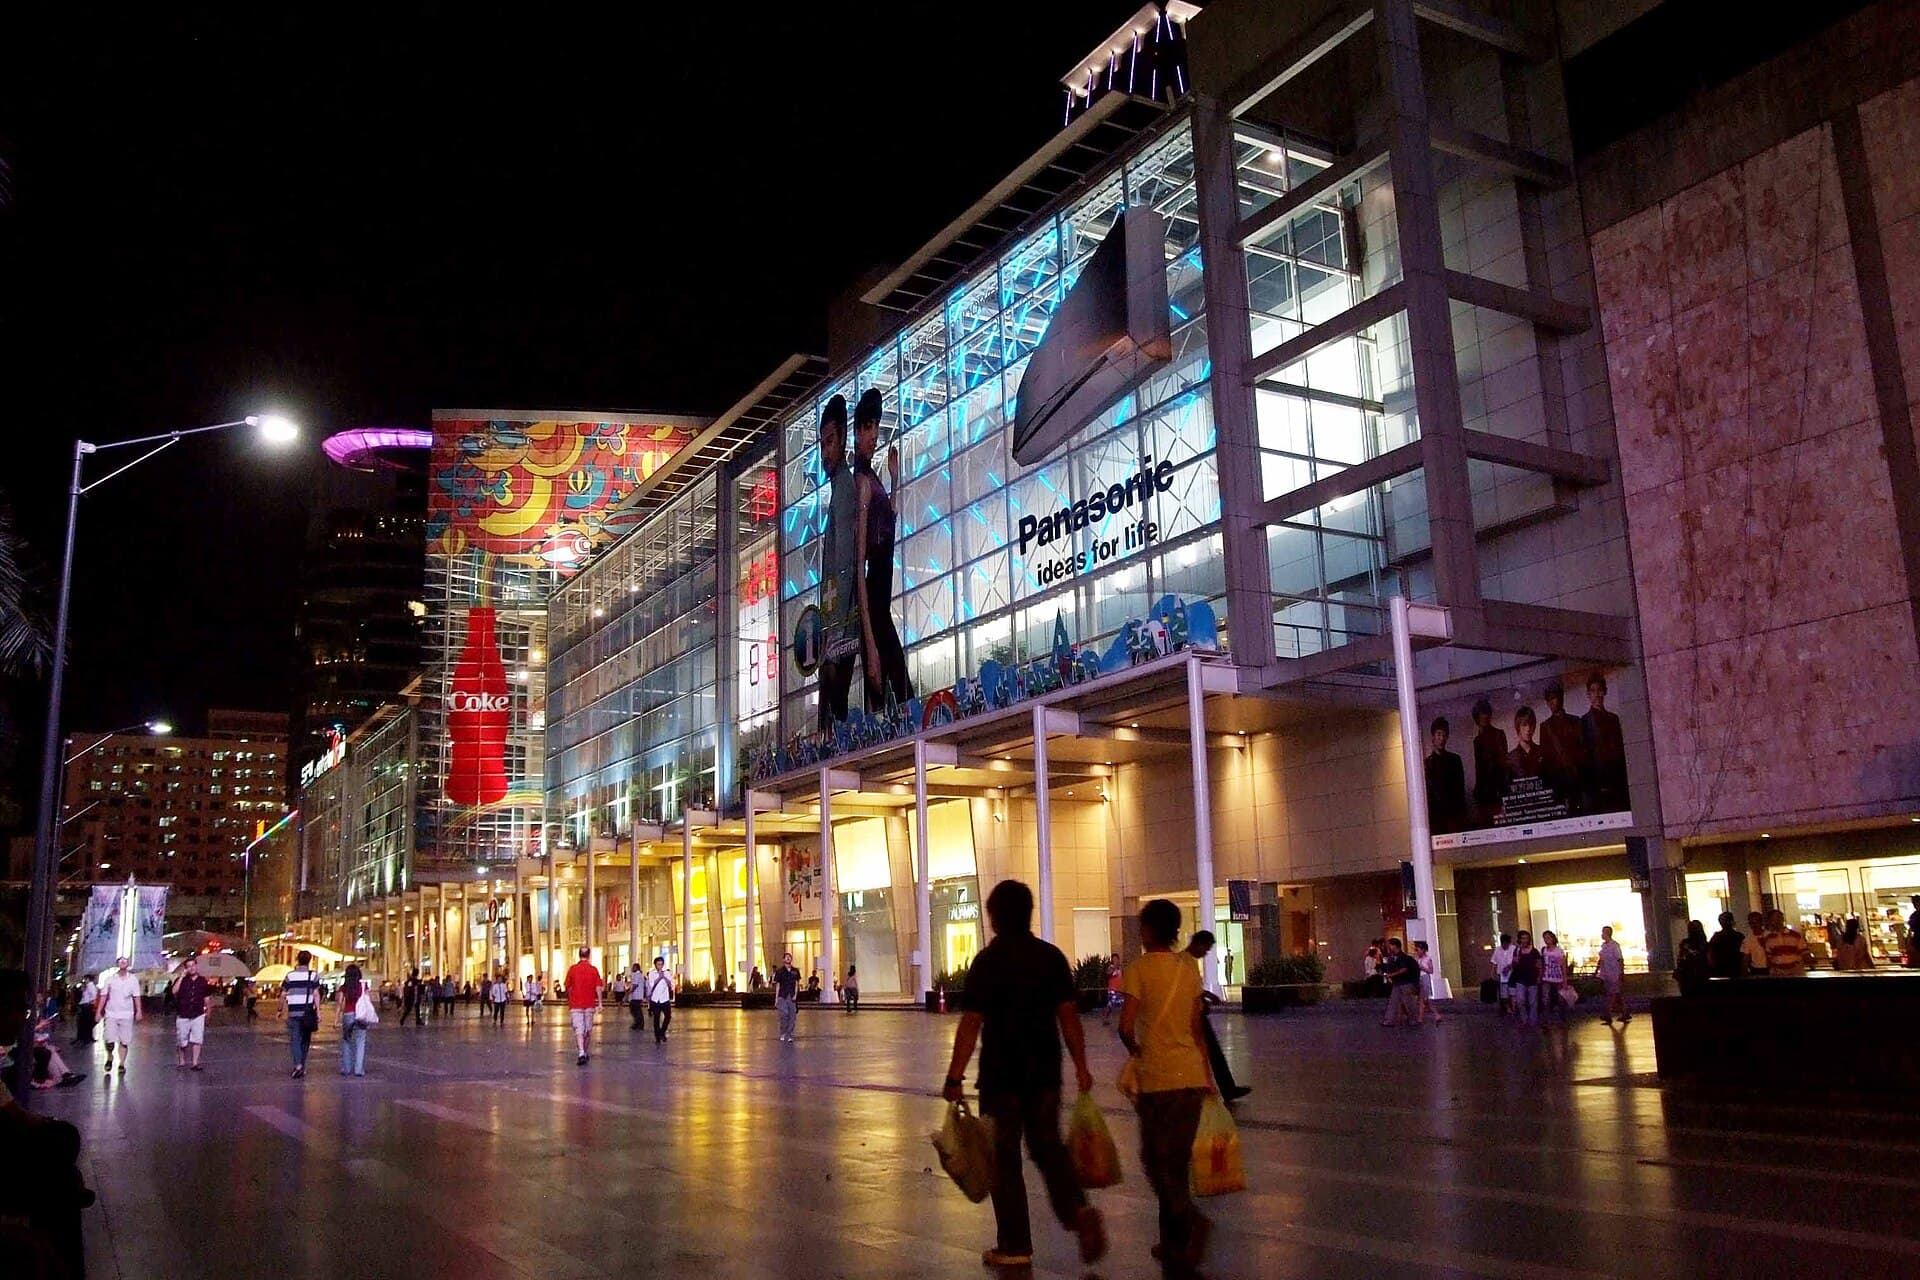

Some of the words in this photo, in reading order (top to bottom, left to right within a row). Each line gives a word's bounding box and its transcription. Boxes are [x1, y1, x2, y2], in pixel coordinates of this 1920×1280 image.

[1018, 454, 1174, 556] Panasonic
[1037, 551, 1087, 586] ideas
[1092, 536, 1119, 563] for
[1124, 519, 1158, 551] life
[448, 691, 512, 713] Coke
